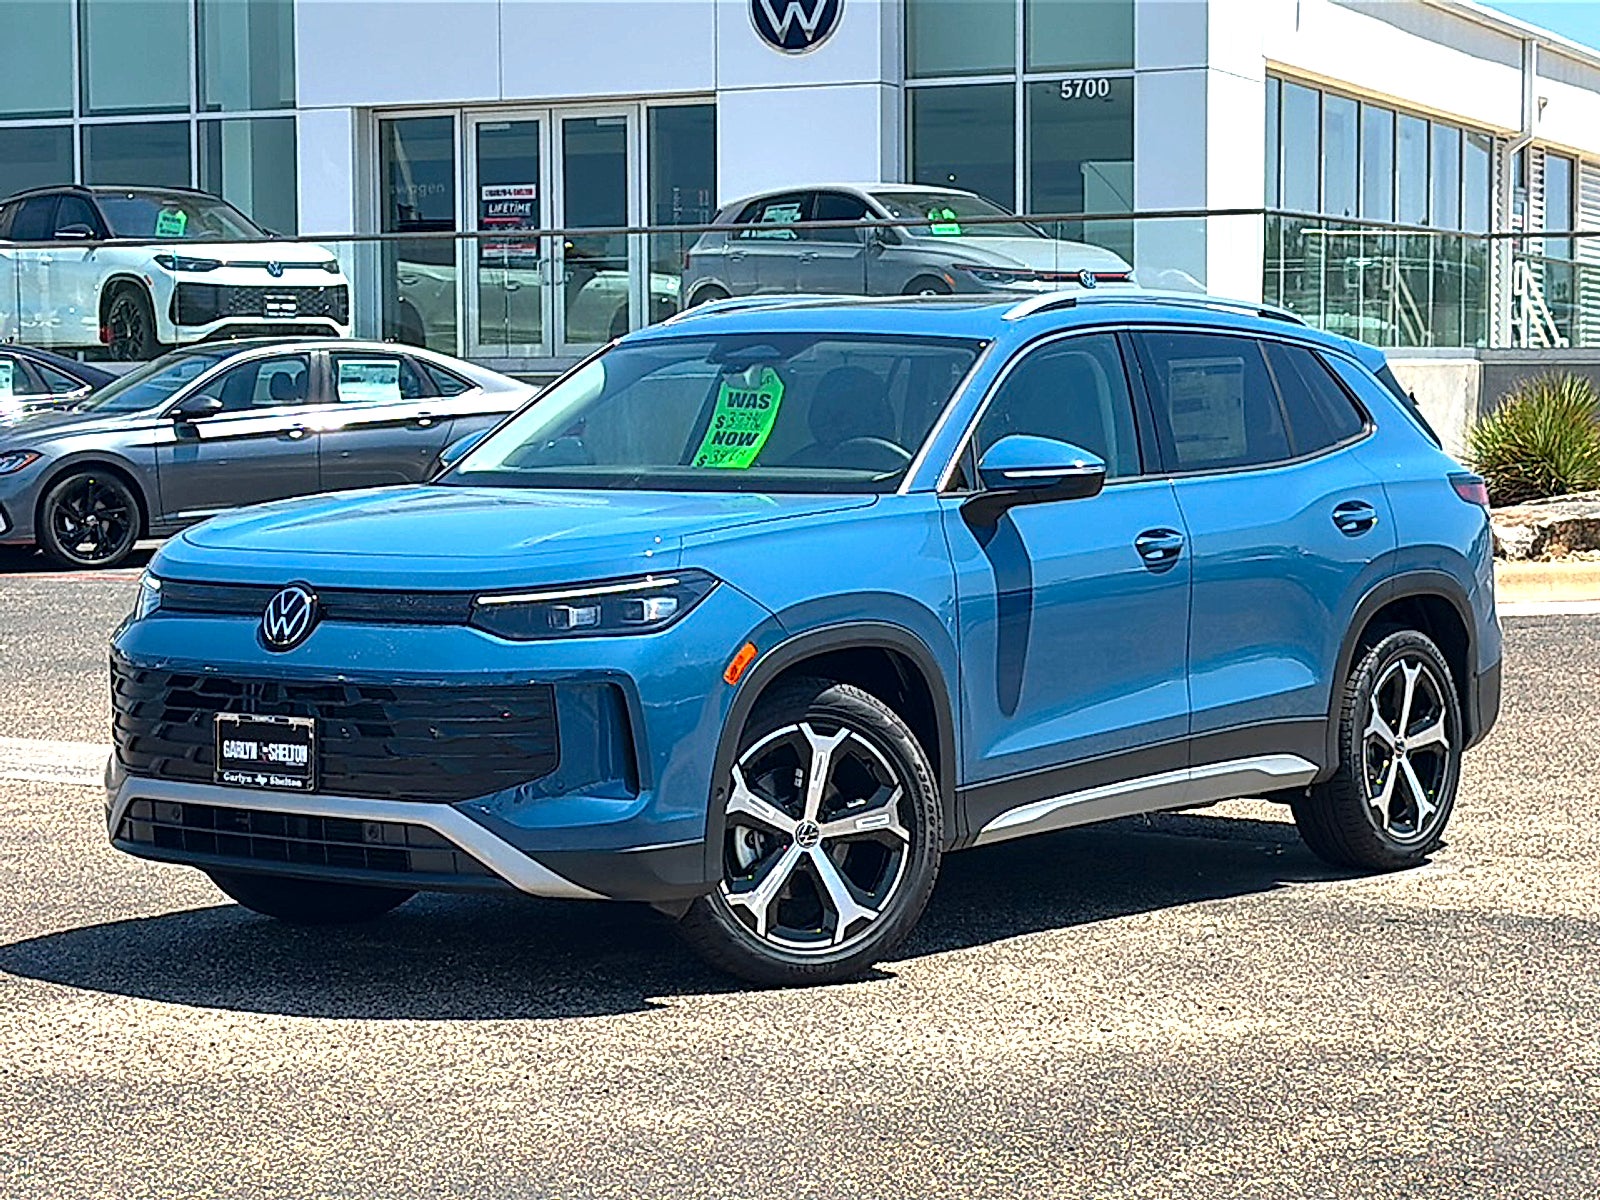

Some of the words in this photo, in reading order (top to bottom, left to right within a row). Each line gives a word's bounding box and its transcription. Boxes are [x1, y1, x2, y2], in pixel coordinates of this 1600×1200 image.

[1061, 78, 1110, 99] 5700
[488, 201, 531, 214] LIFETIME
[726, 391, 772, 410] WAS
[711, 430, 760, 446] NOW
